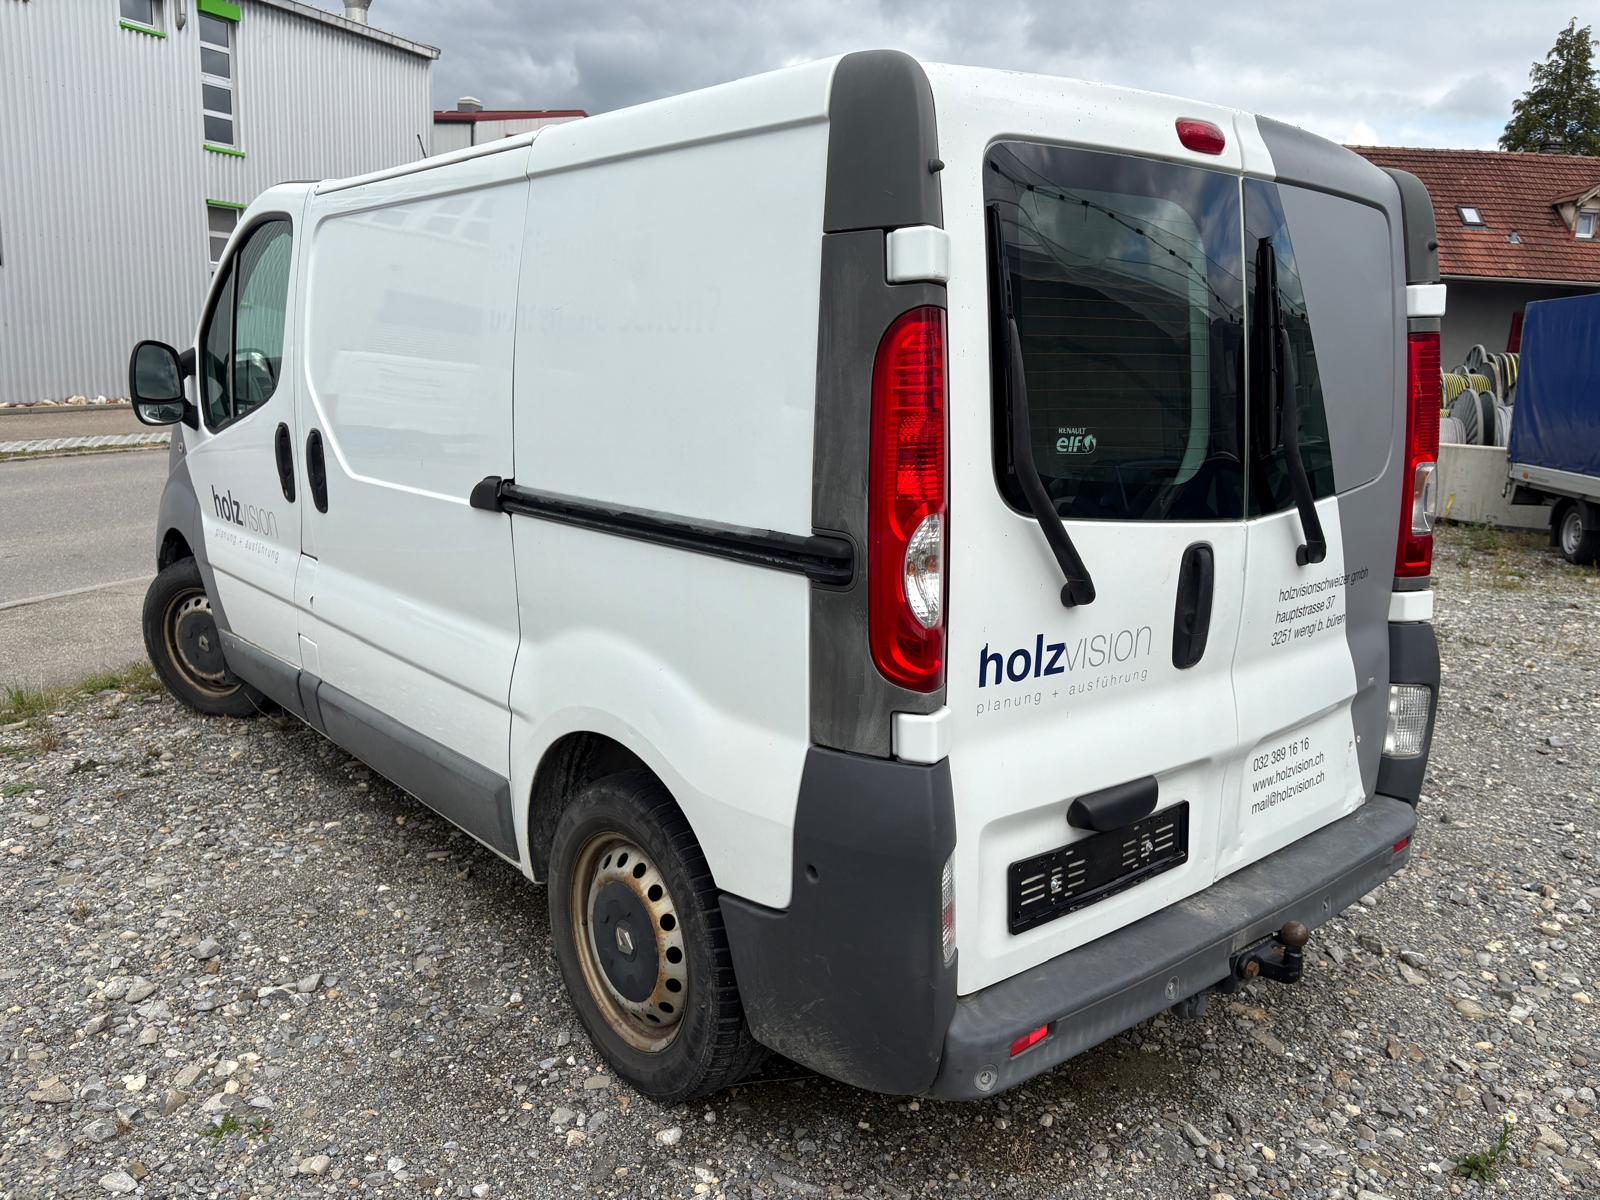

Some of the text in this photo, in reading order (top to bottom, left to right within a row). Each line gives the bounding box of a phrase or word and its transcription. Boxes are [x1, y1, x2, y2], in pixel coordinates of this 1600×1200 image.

[1056, 436, 1083, 452] elf
[1058, 427, 1086, 435] RENAULT
[1275, 595, 1336, 624] hauptstrasse 37
[1271, 613, 1346, 646] 3251 wengi b. büren
[976, 692, 1042, 716] planung
[1069, 668, 1148, 695] ausführung
[1253, 737, 1310, 772] 032 389 16 16
[1252, 752, 1324, 793] www.holzvision.ch
[1251, 771, 1325, 815] mail@holzvision.ch
